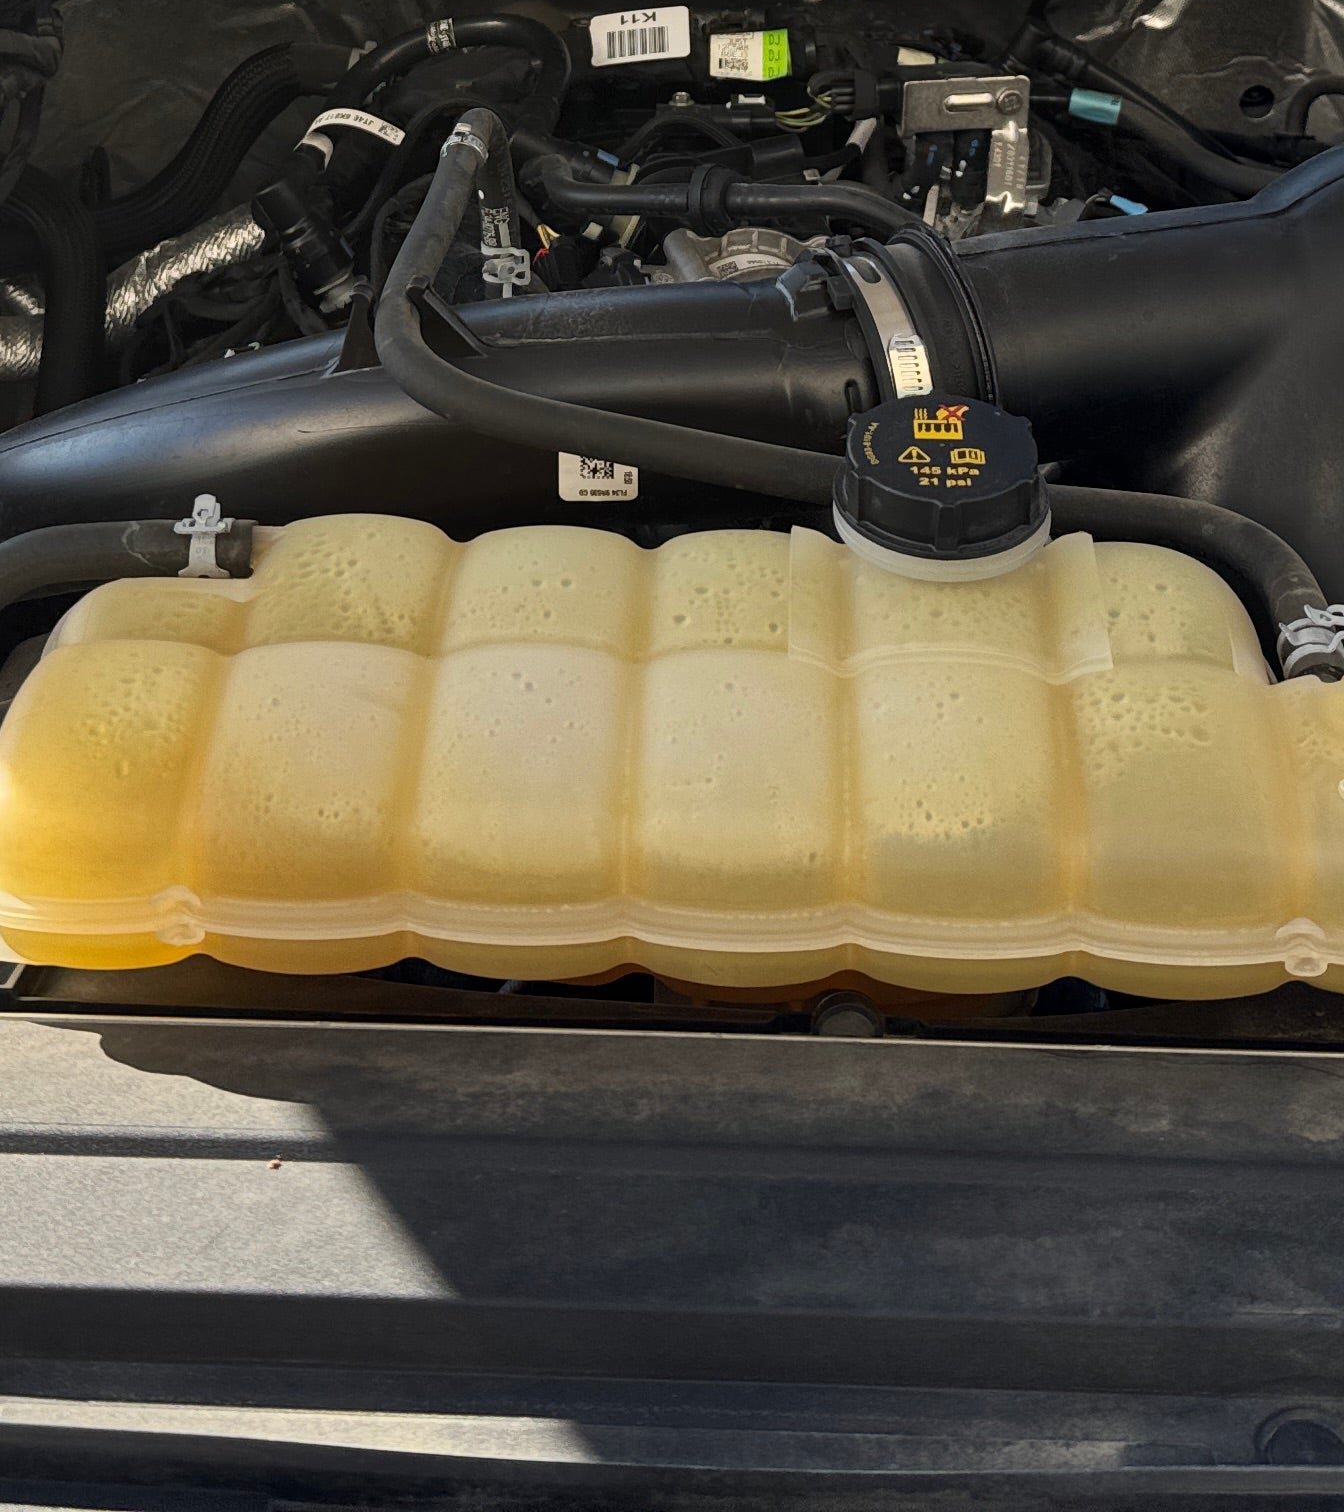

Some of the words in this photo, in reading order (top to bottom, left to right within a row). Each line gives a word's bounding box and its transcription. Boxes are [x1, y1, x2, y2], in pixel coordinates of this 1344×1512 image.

[620, 11, 657, 25] K11
[910, 466, 941, 475] 145
[946, 466, 980, 476] kPa
[918, 477, 939, 486] 21
[946, 477, 972, 488] psi
